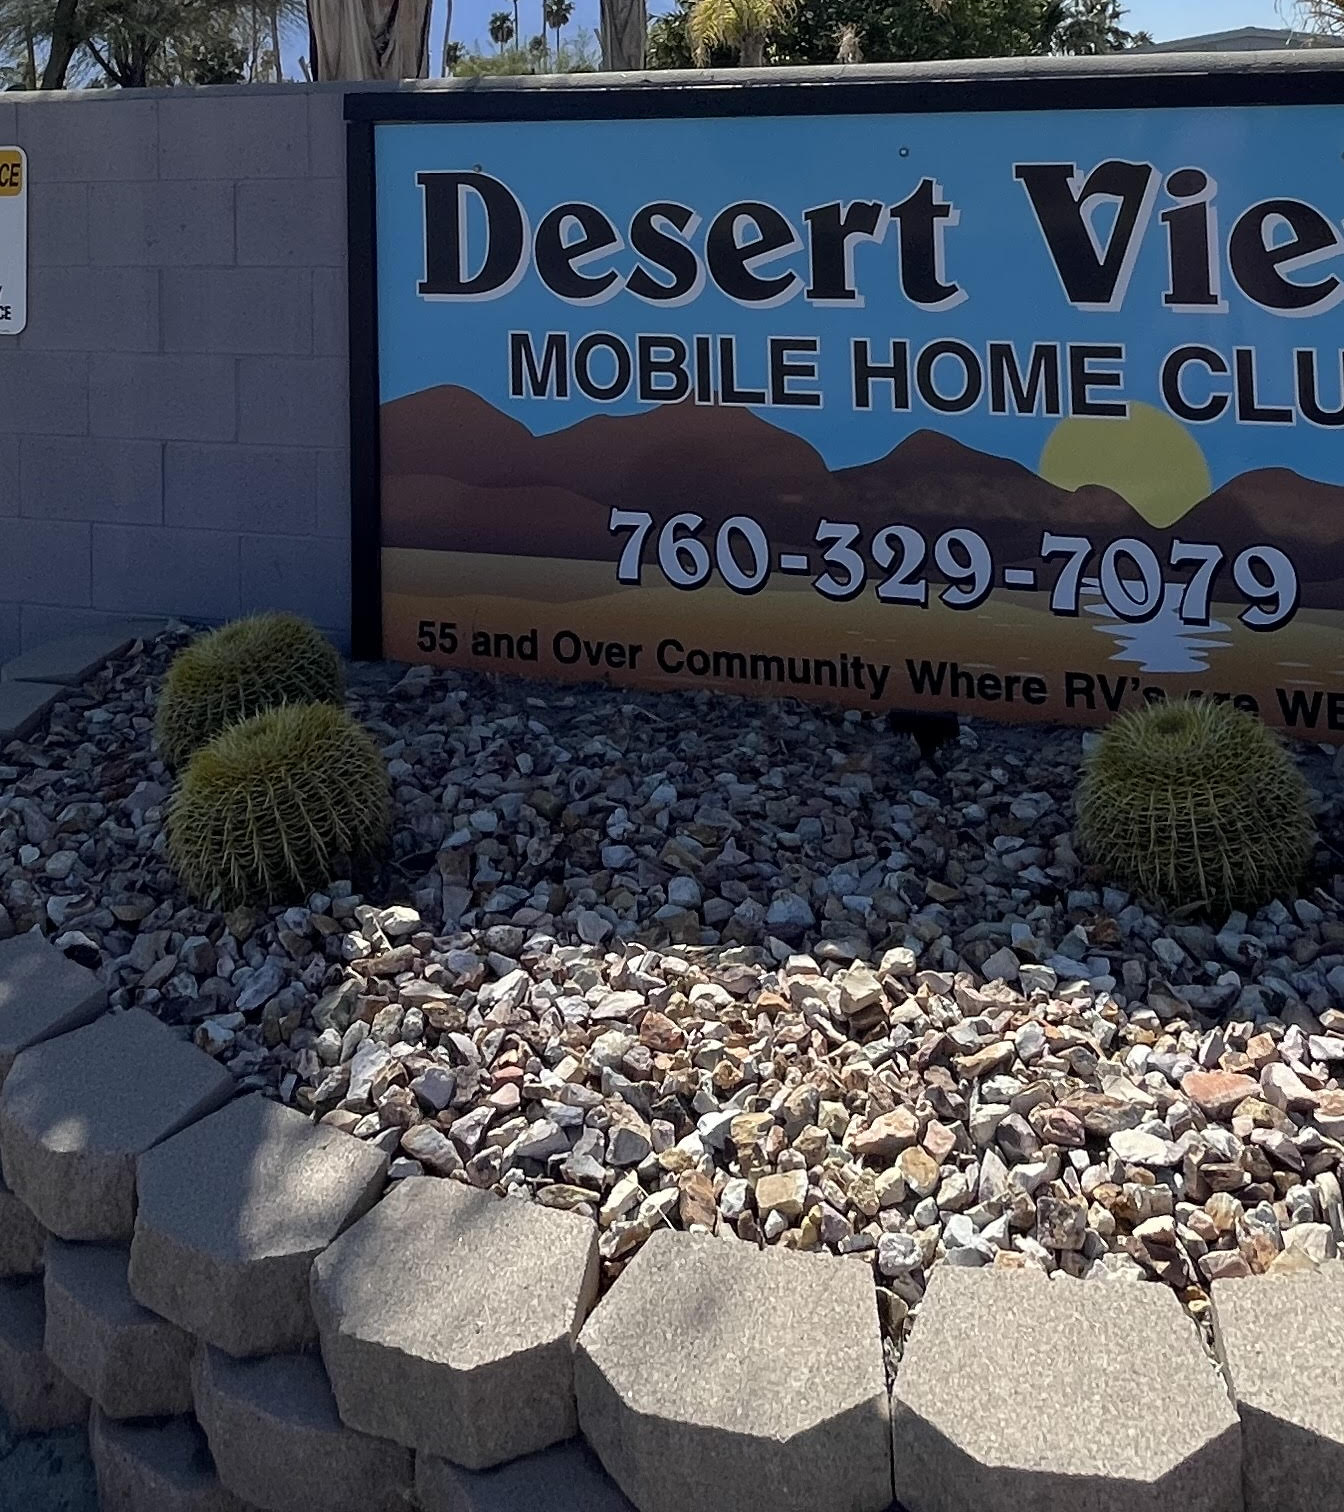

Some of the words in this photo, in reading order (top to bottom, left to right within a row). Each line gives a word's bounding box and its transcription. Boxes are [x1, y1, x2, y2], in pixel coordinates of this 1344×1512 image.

[415, 169, 970, 313] Desert
[507, 329, 823, 407] MOBILE
[850, 336, 1131, 420] HOME
[607, 506, 1301, 633] 760-329-7079
[416, 620, 458, 655] 55
[471, 628, 539, 662] and
[552, 630, 643, 670] Over
[656, 638, 891, 701] Community
[906, 658, 1049, 706] Where
